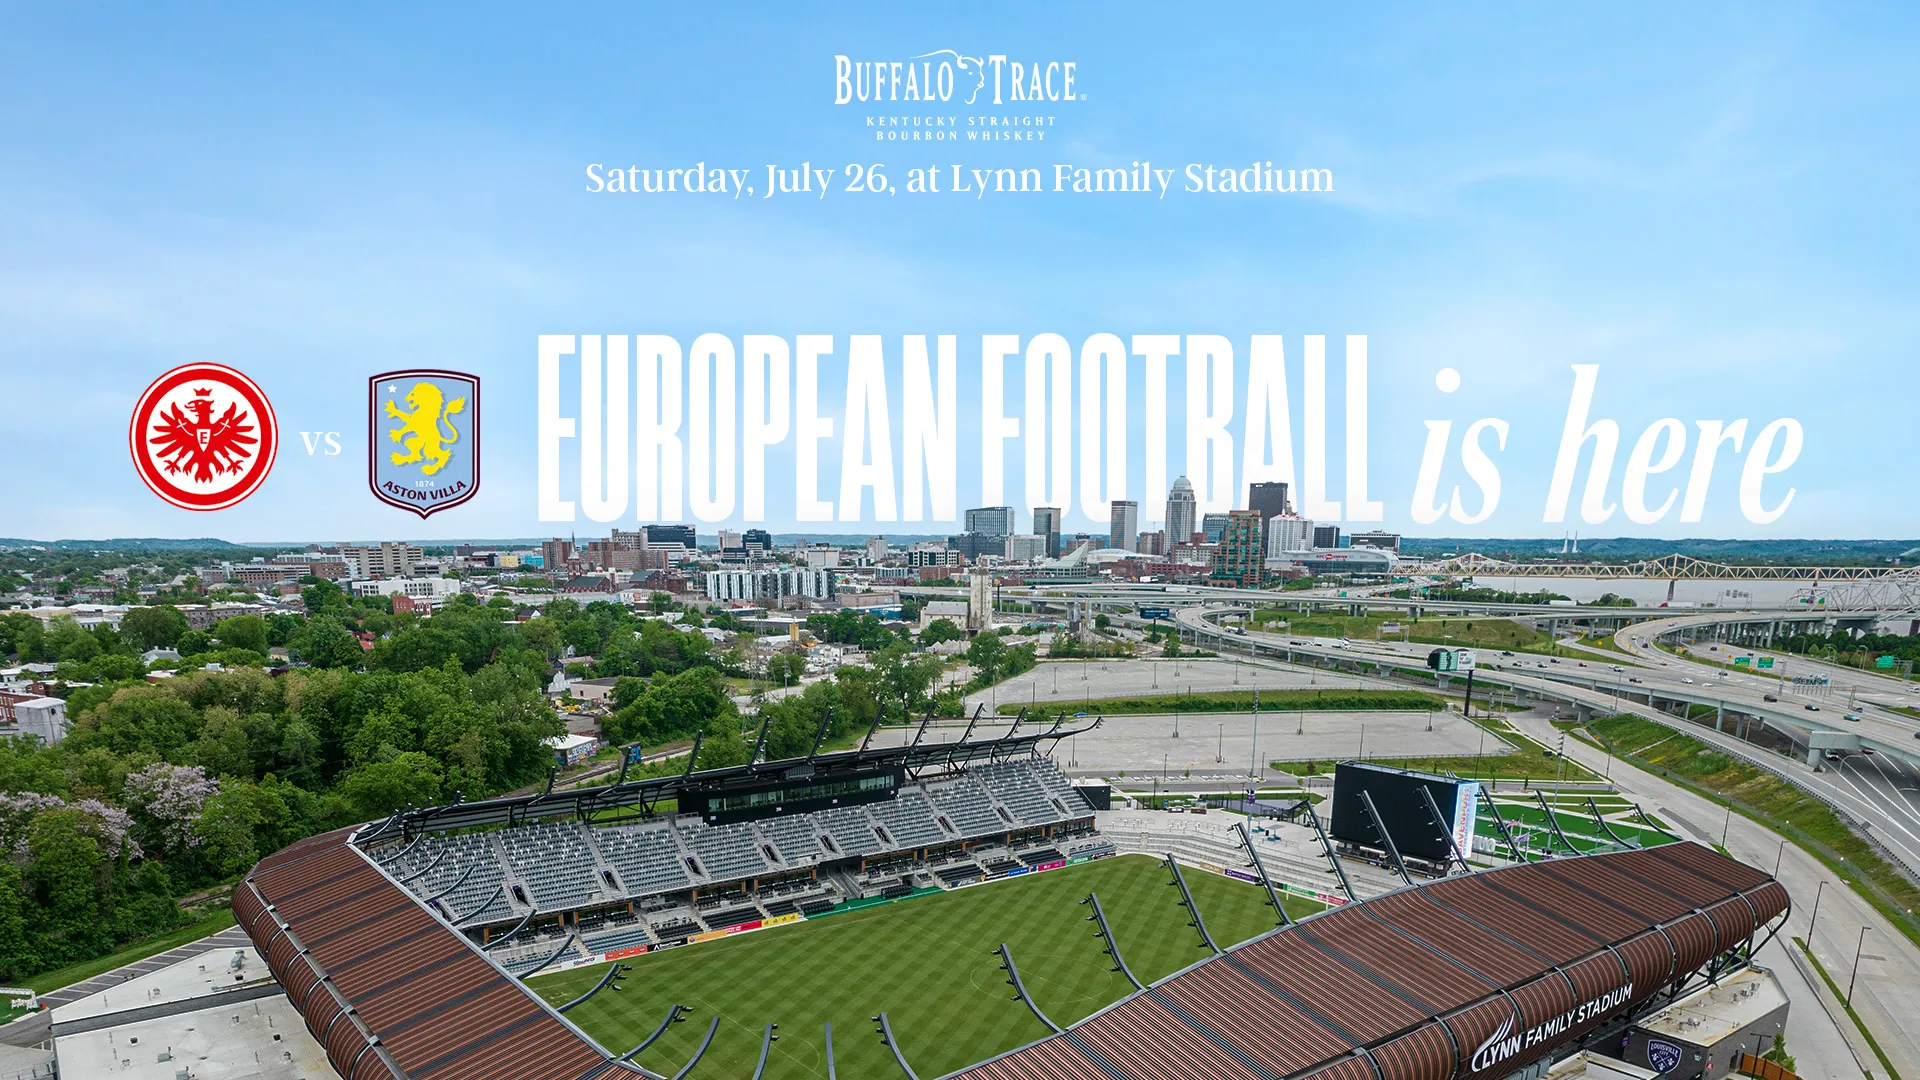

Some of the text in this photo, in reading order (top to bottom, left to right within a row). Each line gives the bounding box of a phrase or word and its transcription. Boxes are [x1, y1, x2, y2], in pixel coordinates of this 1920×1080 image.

[1481, 983, 1633, 1071] LYNN FAMILY STADIUM
[1650, 1042, 1679, 1058] LOUISVILLE
